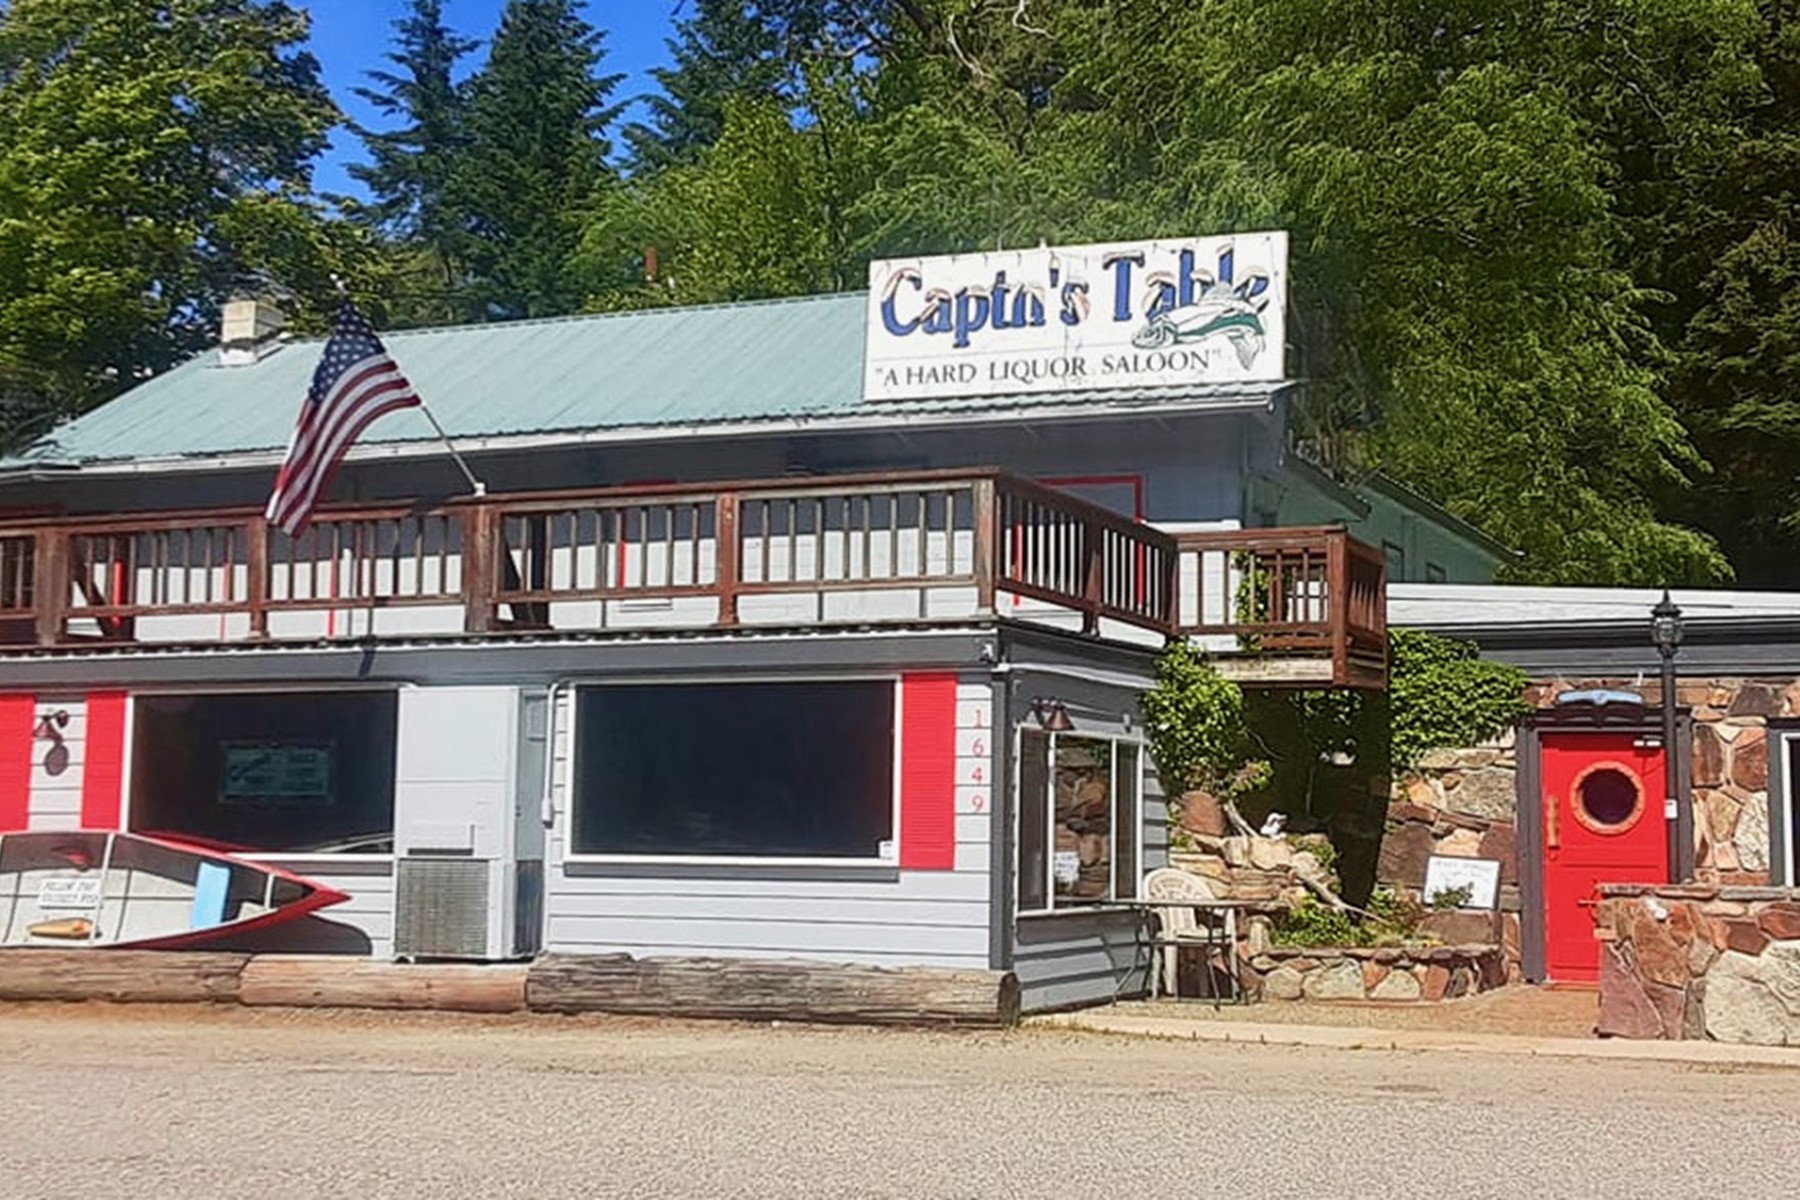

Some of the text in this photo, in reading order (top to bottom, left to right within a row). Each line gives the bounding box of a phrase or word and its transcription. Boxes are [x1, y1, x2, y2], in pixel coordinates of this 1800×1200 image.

[880, 241, 1270, 348] Captn's Table
[906, 362, 977, 386] HARD
[989, 356, 1087, 385] LIQUOR
[1101, 348, 1221, 376] SALOON"
